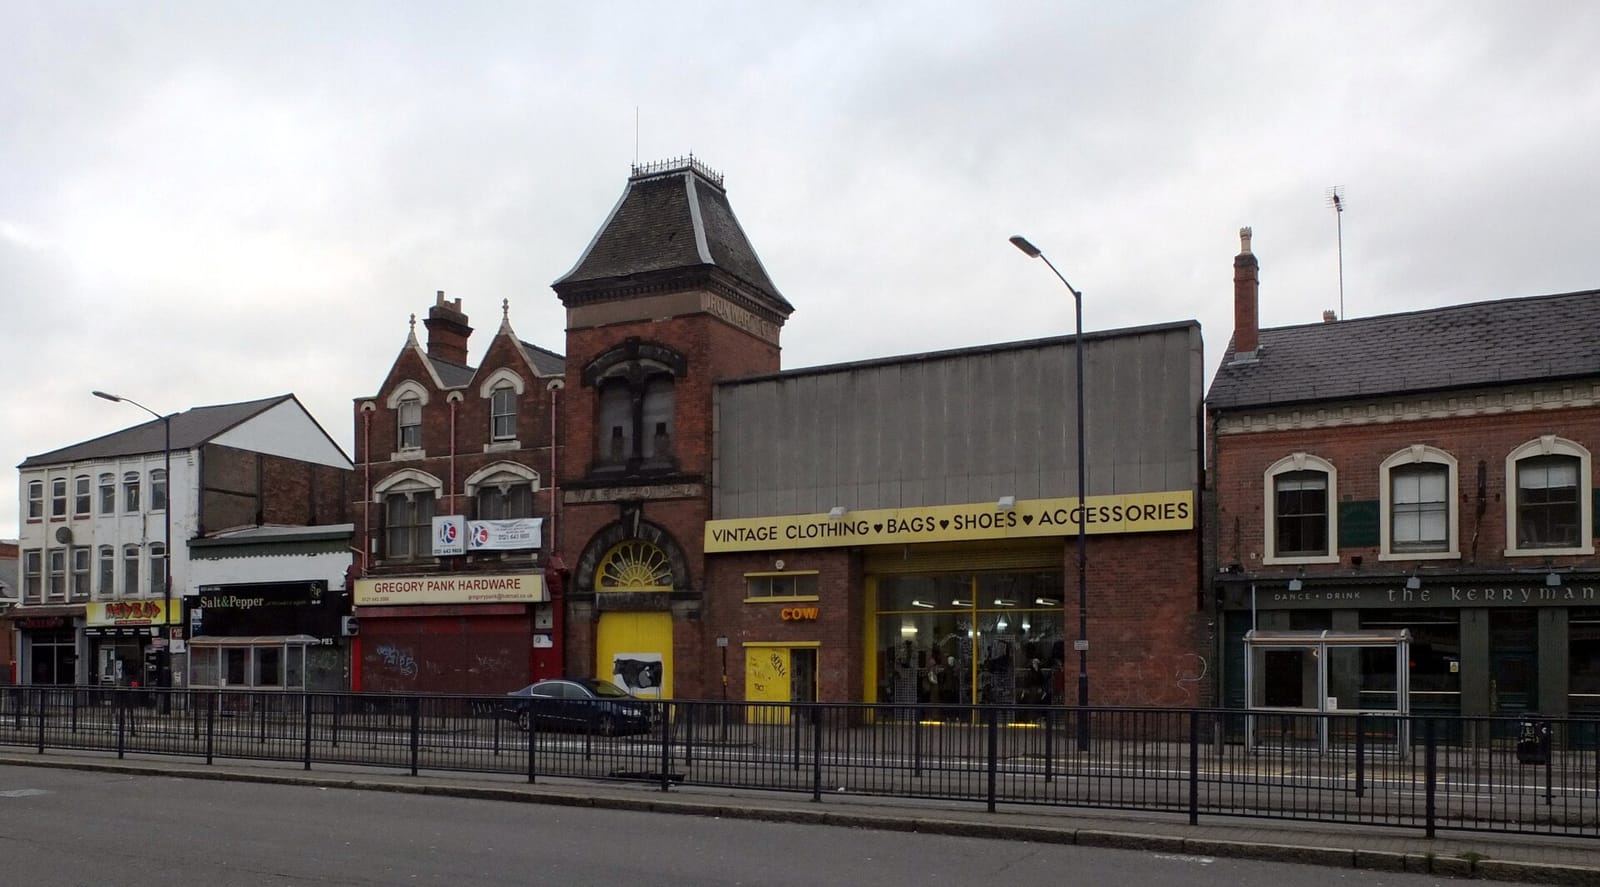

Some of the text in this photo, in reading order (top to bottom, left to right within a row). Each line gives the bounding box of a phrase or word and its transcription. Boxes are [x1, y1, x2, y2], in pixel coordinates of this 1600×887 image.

[712, 502, 1189, 543] VINTAGE CLOTHING BAGS SHOES ACCESSORIES
[374, 578, 521, 593] GREGORY PANK HARDWARE
[200, 595, 264, 610] Salt&Pepper
[1274, 591, 1361, 601] DANCE DRINK
[781, 607, 819, 621] COW
